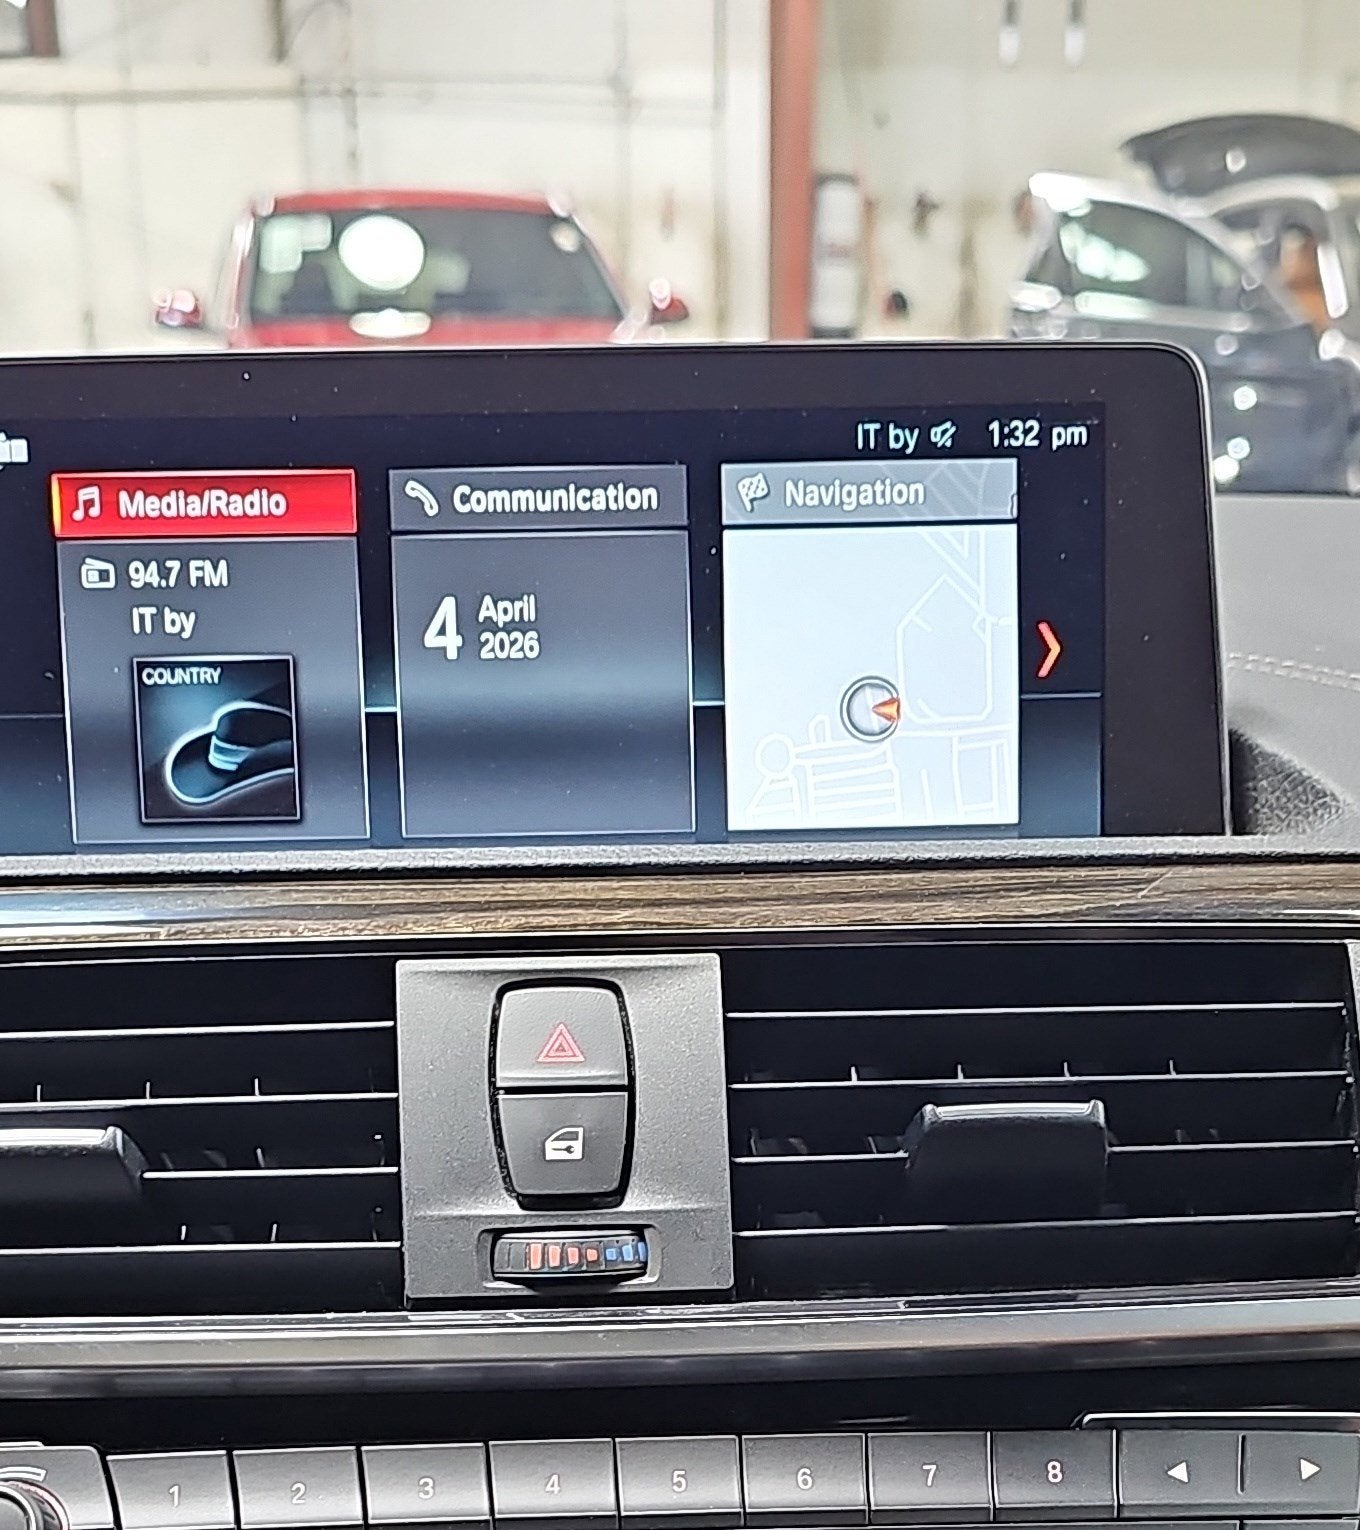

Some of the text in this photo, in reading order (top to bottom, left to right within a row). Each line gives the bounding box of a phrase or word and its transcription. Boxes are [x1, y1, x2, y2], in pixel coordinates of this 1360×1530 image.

[857, 422, 920, 455] IT by
[988, 419, 1089, 451] 1:32 pm
[118, 488, 287, 518] Media/Radio
[453, 482, 658, 513] Communication
[785, 477, 925, 511] Navigation
[128, 559, 228, 589] 94.7 FM
[132, 606, 196, 639] IT by
[478, 594, 536, 628] April
[423, 596, 463, 660] 4
[479, 634, 540, 660] 2026
[141, 666, 221, 686] COUNTRY
[671, 1469, 687, 1492] 5
[796, 1467, 813, 1490] 6
[922, 1464, 937, 1487] 7
[1047, 1460, 1063, 1484] 8
[168, 1485, 182, 1508] 1
[290, 1482, 307, 1505] 2
[418, 1477, 435, 1500] 3
[544, 1474, 561, 1497] 4
